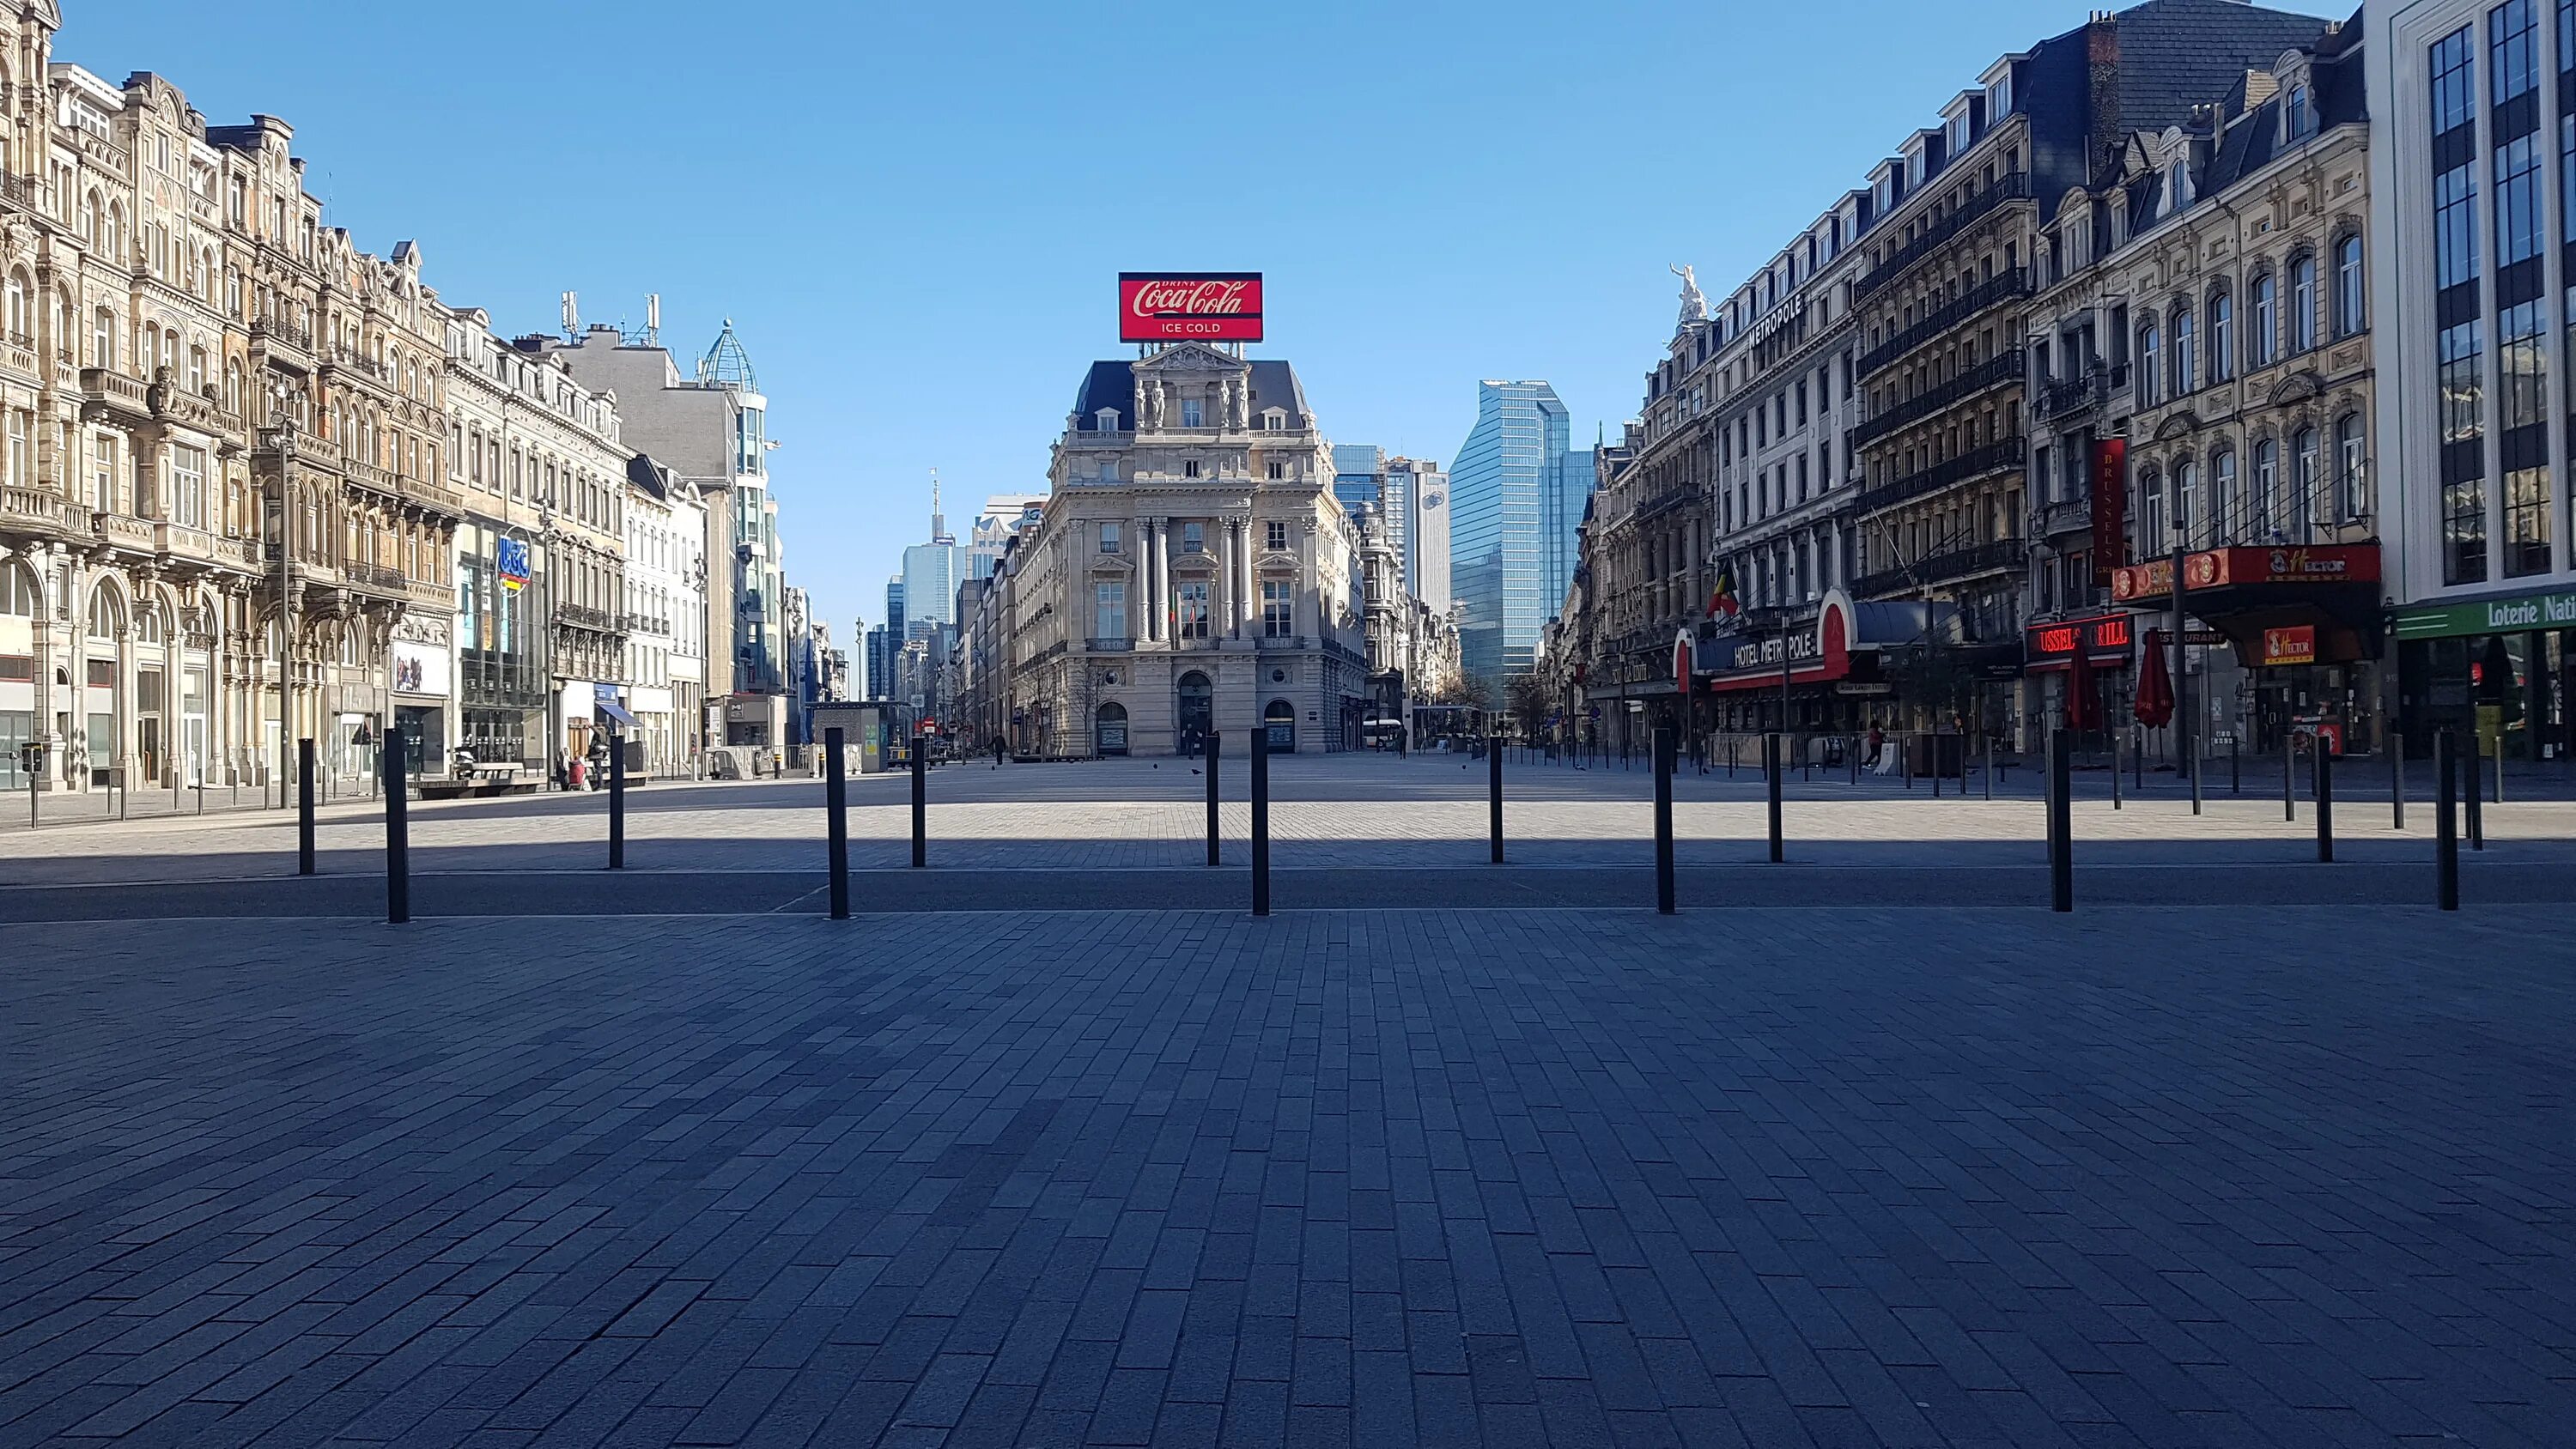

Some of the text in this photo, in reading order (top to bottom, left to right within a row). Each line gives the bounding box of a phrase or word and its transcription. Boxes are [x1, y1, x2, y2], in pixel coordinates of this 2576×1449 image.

[1133, 281, 1249, 317] Coca-Cola
[1162, 324, 1220, 332] ICE COLD
[1748, 294, 1801, 349] METROPOLE
[1023, 509, 1040, 520] AG
[2103, 454, 2113, 557] BRUSSELS
[499, 537, 529, 577] UGC
[2488, 595, 2576, 627] Loterie Nati
[1735, 633, 1811, 666] HOTEL METRPOLE
[2090, 621, 2130, 646] GRILL
[2158, 633, 2226, 643] ESTURANT
[2281, 632, 2310, 656] HECTOR
